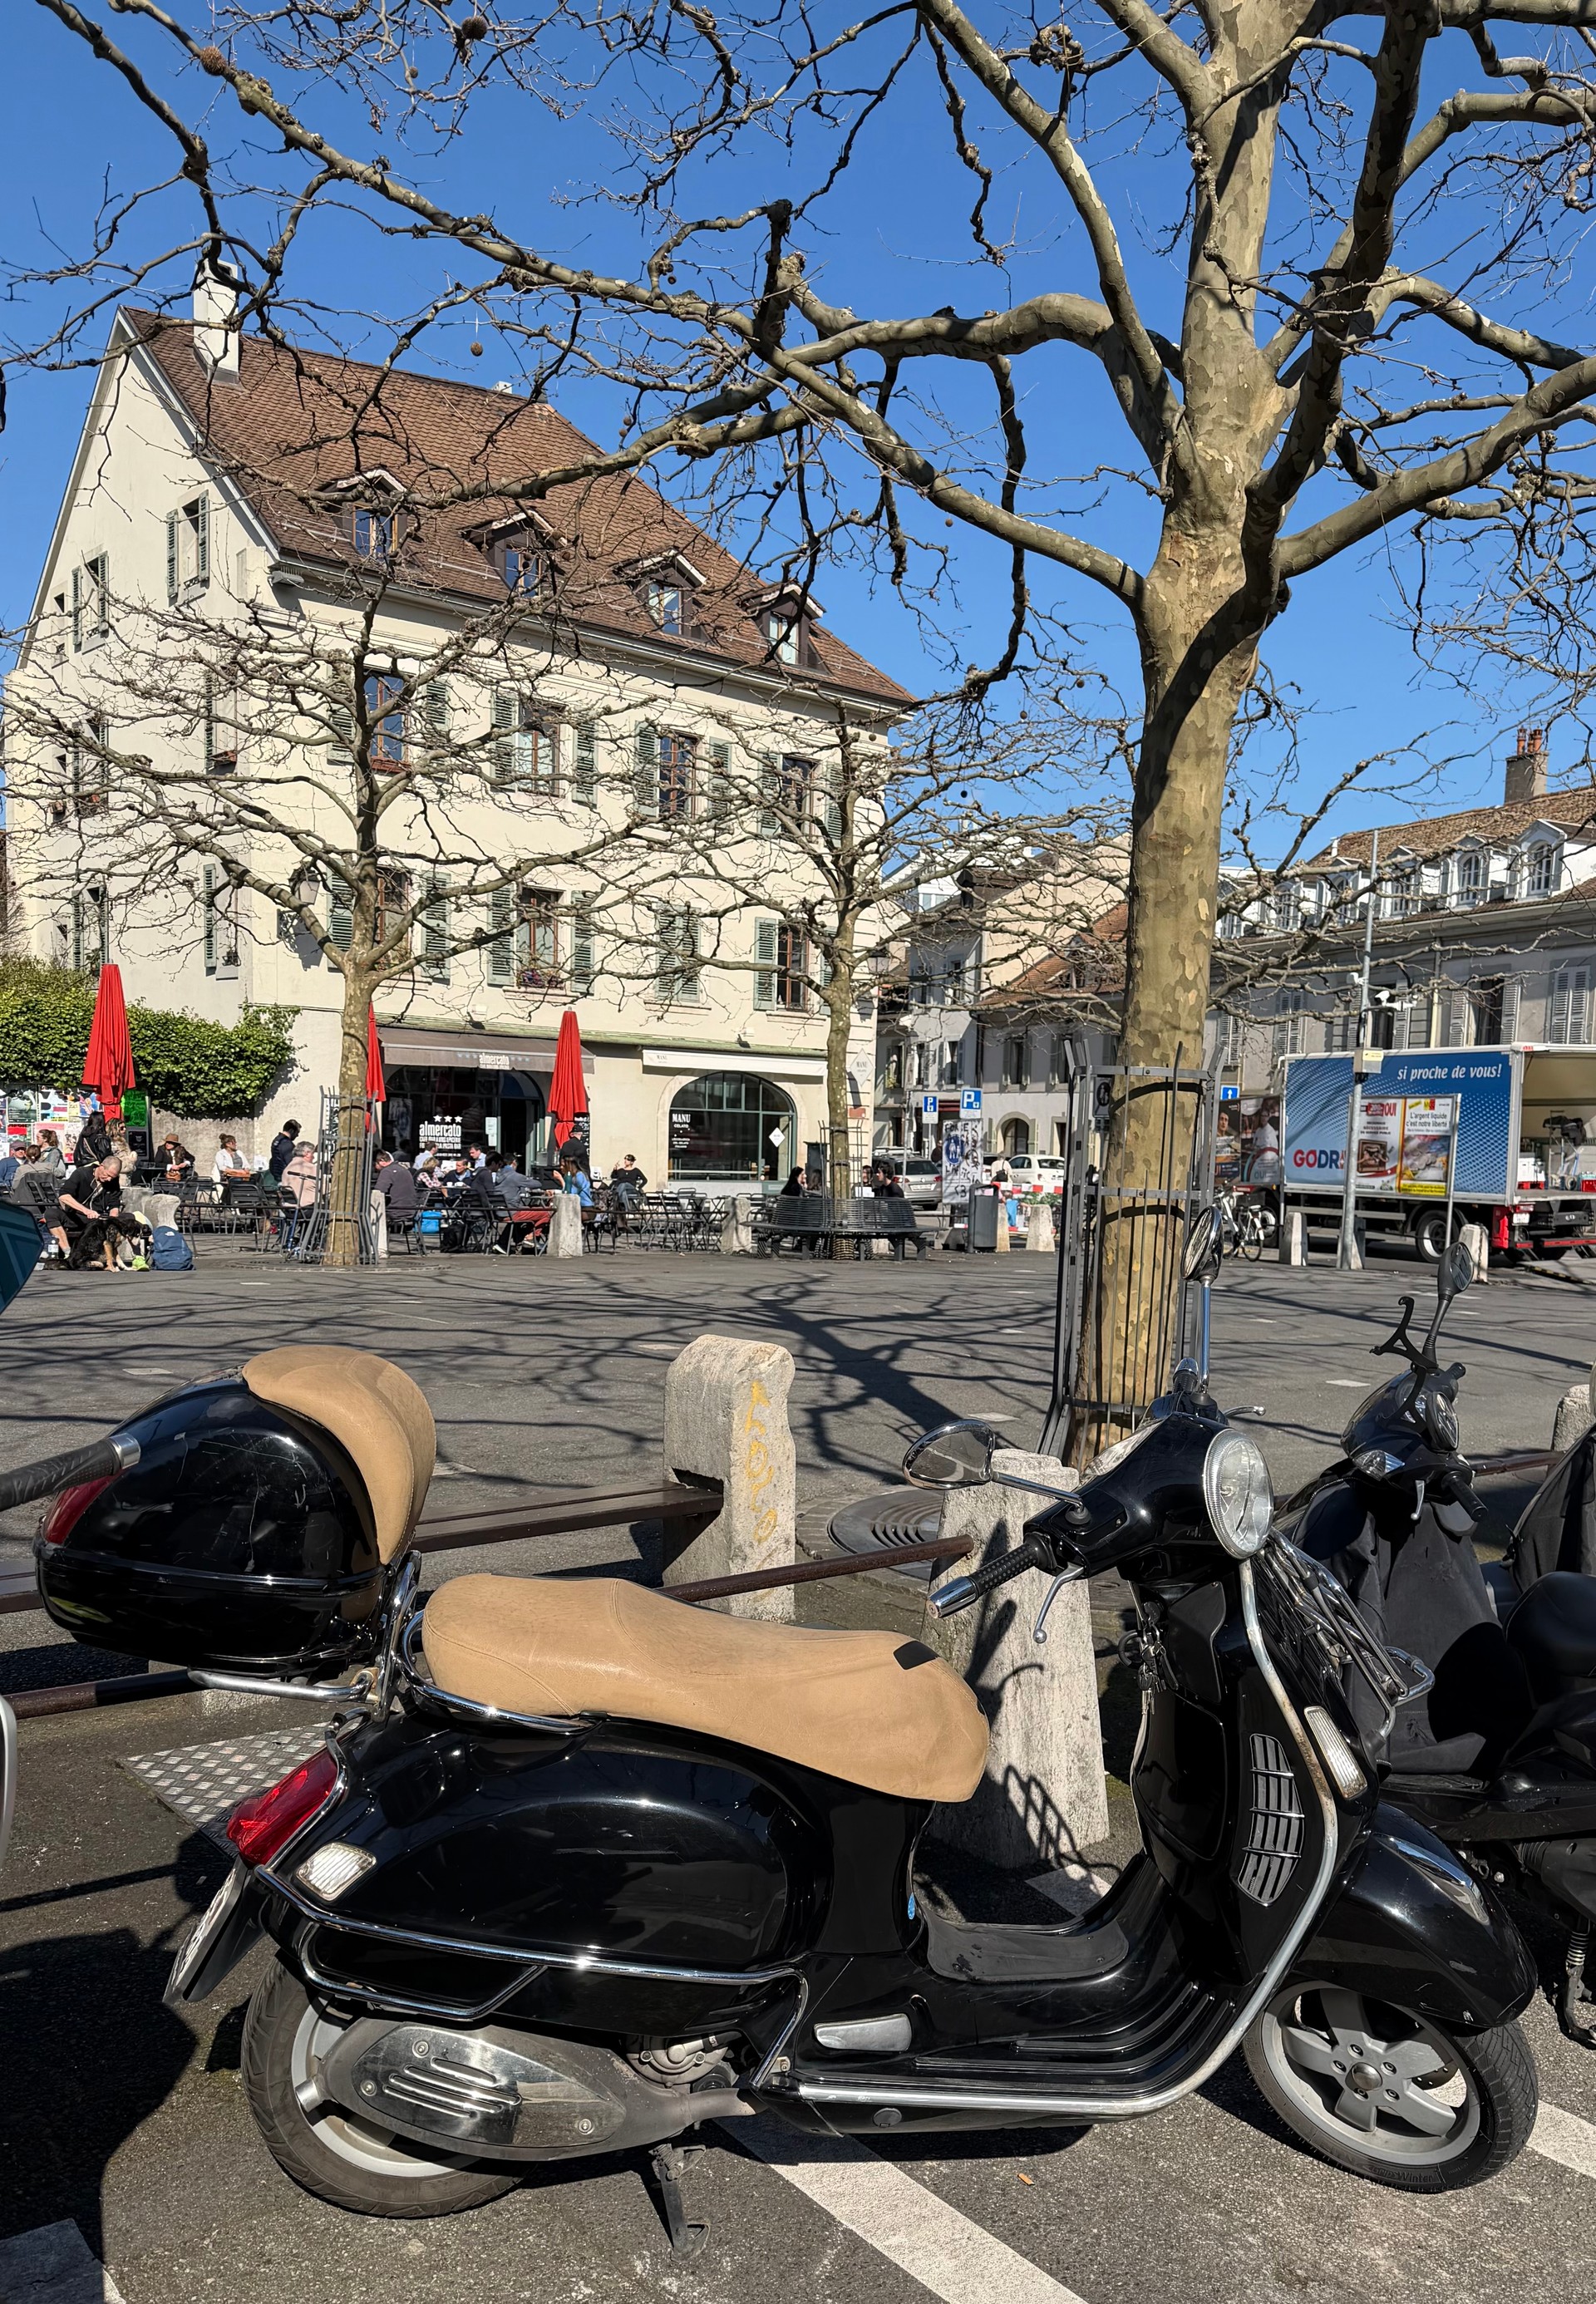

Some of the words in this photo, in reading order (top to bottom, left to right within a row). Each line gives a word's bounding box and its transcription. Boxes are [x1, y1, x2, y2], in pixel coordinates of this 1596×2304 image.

[479, 1052, 510, 1066] almercato
[1397, 1066, 1408, 1080] si
[1410, 1066, 1448, 1081] proche
[1451, 1065, 1466, 1078] de
[1470, 1063, 1502, 1078] vous!
[963, 1090, 975, 1108] P
[1384, 1102, 1397, 1117] OUI
[1410, 1112, 1430, 1120] L'argent
[1431, 1112, 1447, 1120] liquide
[672, 1114, 691, 1123] MANU
[419, 1120, 461, 1137] almercato
